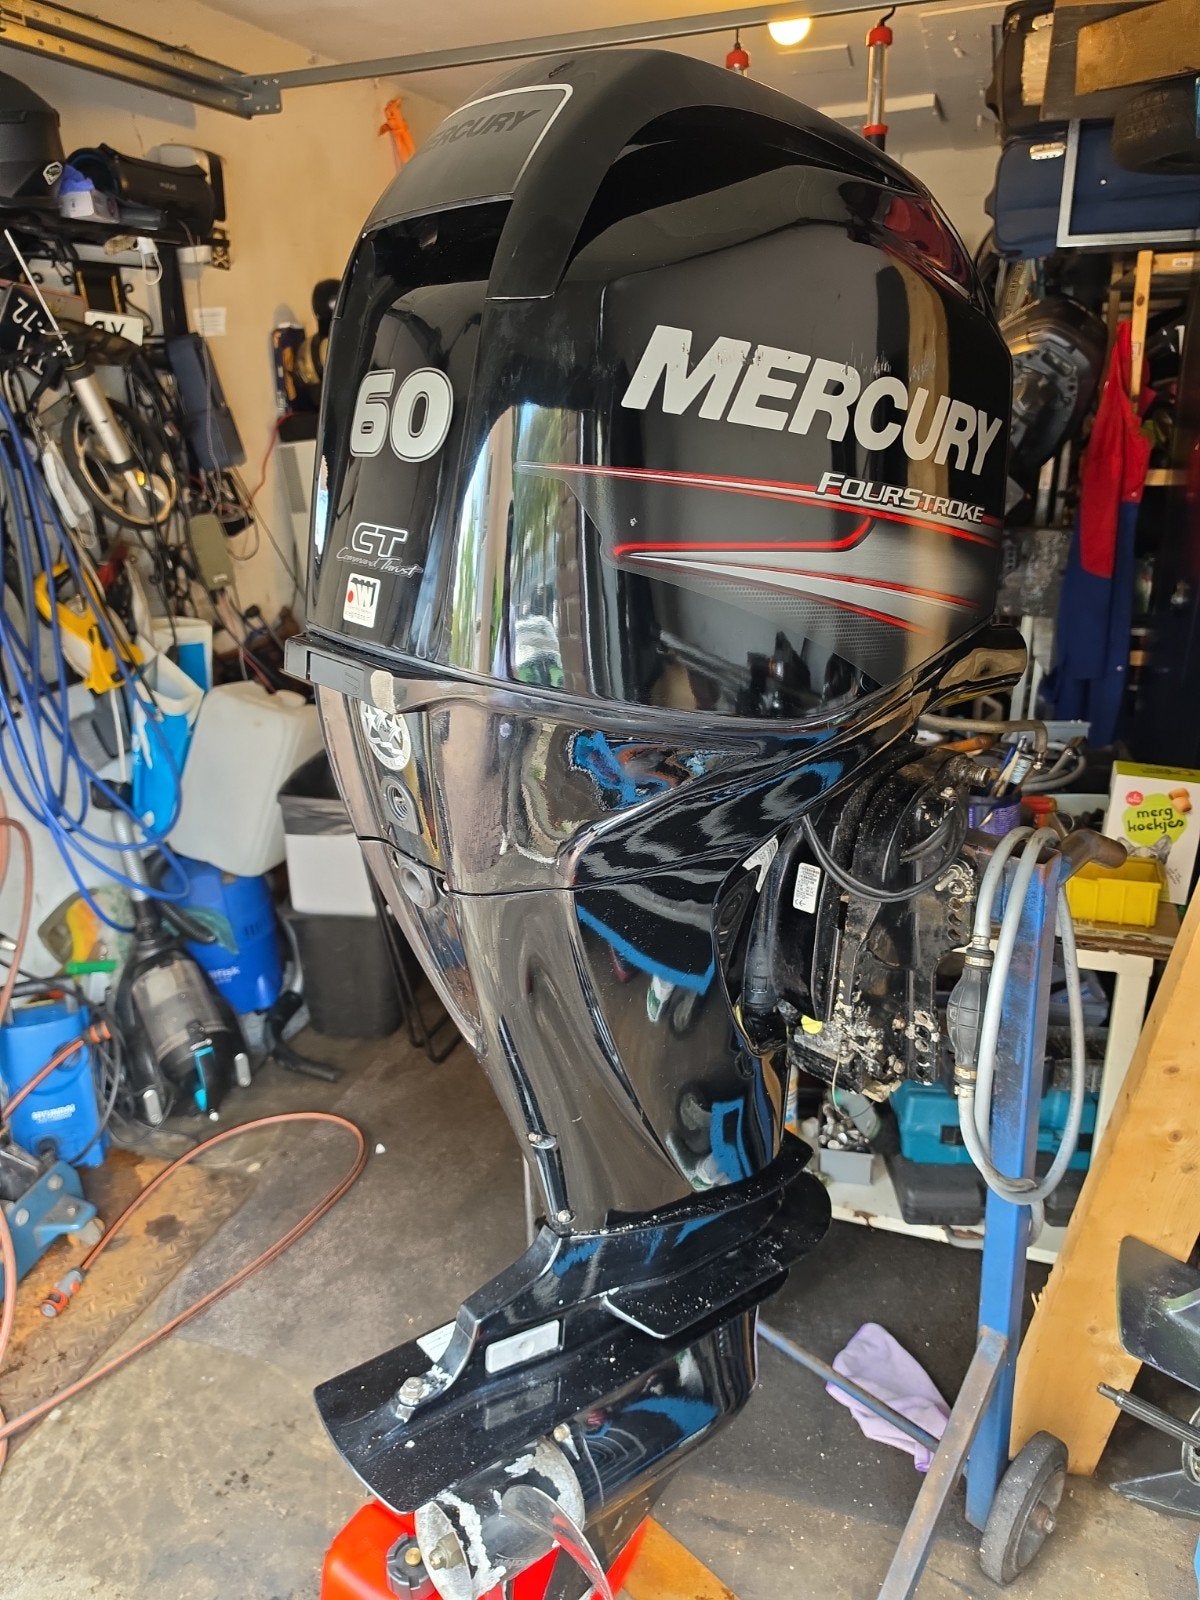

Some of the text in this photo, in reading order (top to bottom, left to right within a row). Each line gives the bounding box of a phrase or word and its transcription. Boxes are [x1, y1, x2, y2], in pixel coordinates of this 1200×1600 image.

[350, 366, 454, 463] 60
[621, 324, 1002, 475] MERCURY
[336, 546, 424, 577] Command Thrust
[1127, 818, 1185, 834] koekjes
[1136, 807, 1174, 820] merg
